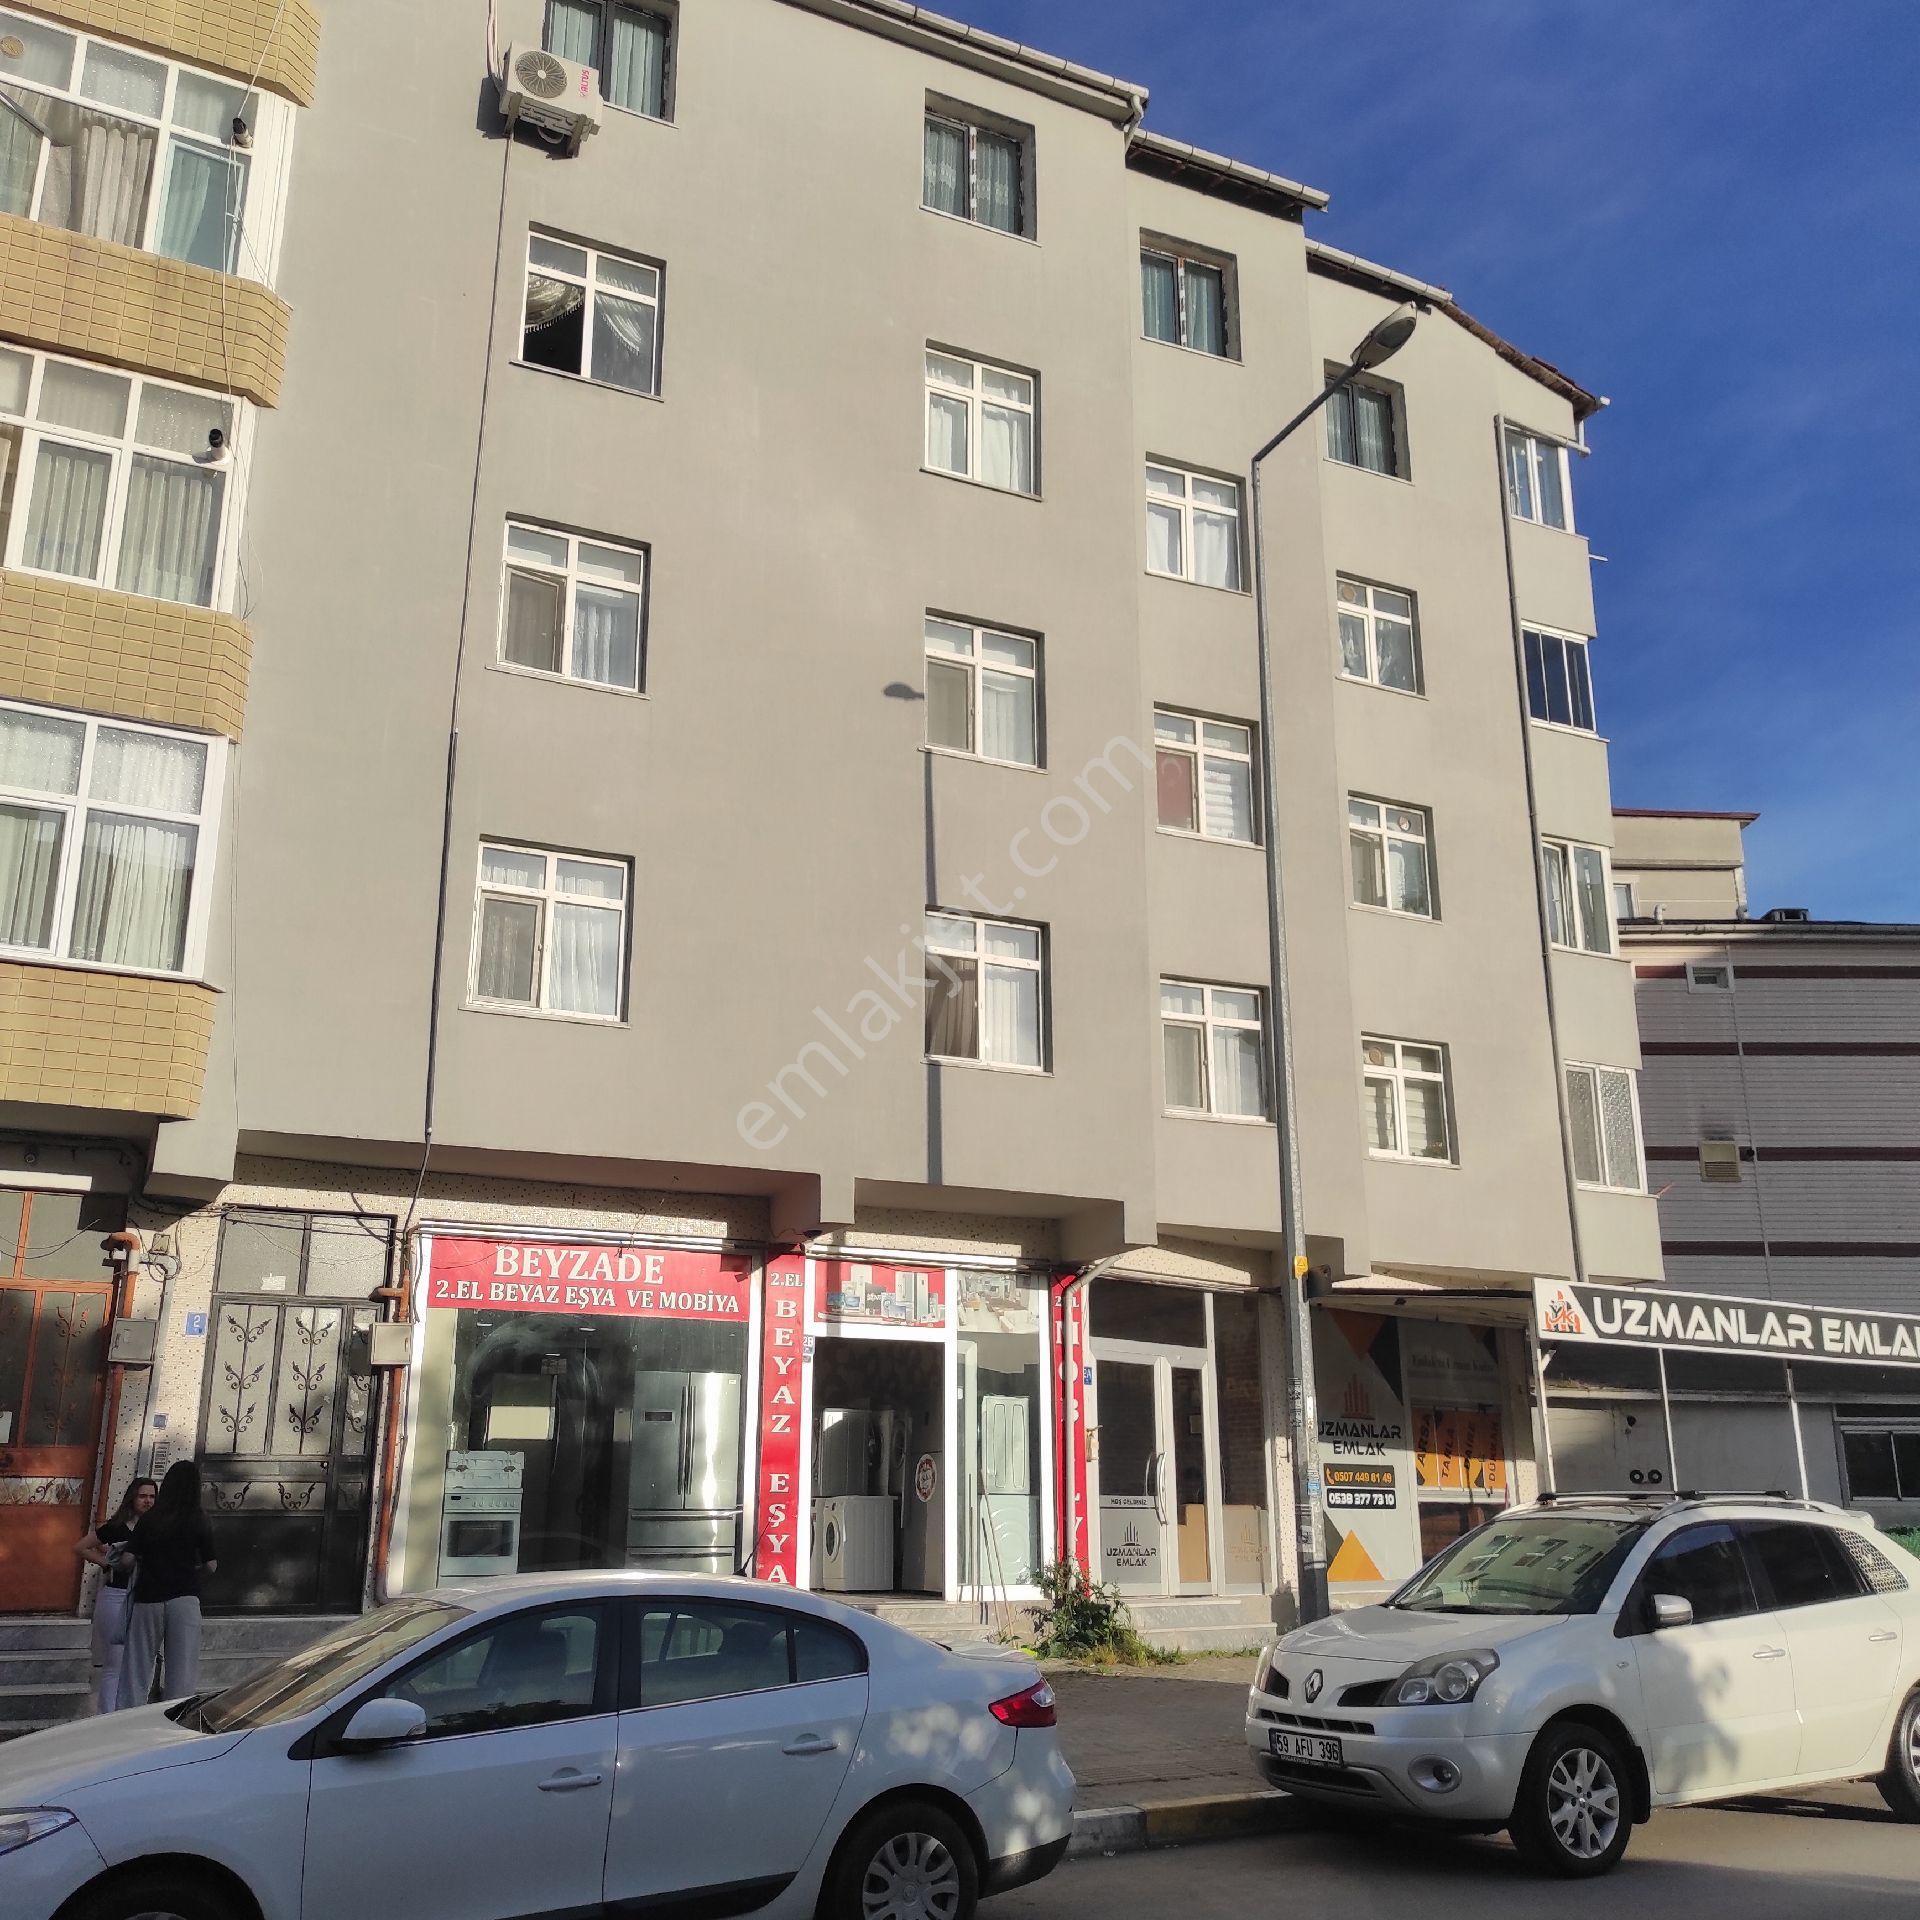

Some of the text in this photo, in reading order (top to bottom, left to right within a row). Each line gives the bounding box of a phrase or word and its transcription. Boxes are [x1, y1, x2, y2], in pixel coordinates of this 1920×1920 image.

[580, 69, 590, 92] ALTUS
[494, 1246, 665, 1285] BEYZADE
[770, 1272, 803, 1287] 2.EL
[436, 1279, 739, 1313] 2.EL BEYAZ EŞYA VE MOBİYA
[193, 1314, 201, 1328] 2
[1592, 1296, 1815, 1350] UZMANLAR
[767, 1299, 798, 1583] BEYAZ EŞYA
[1333, 1440, 1386, 1457] EMLAK
[1334, 1471, 1353, 1482] 0507
[1328, 1492, 1353, 1504] 0538
[1354, 1493, 1371, 1505] 377
[1106, 1547, 1157, 1557] UZMANLAR
[1116, 1558, 1147, 1567] EMLAK
[1277, 1734, 1339, 1761] 59 AFU 396
